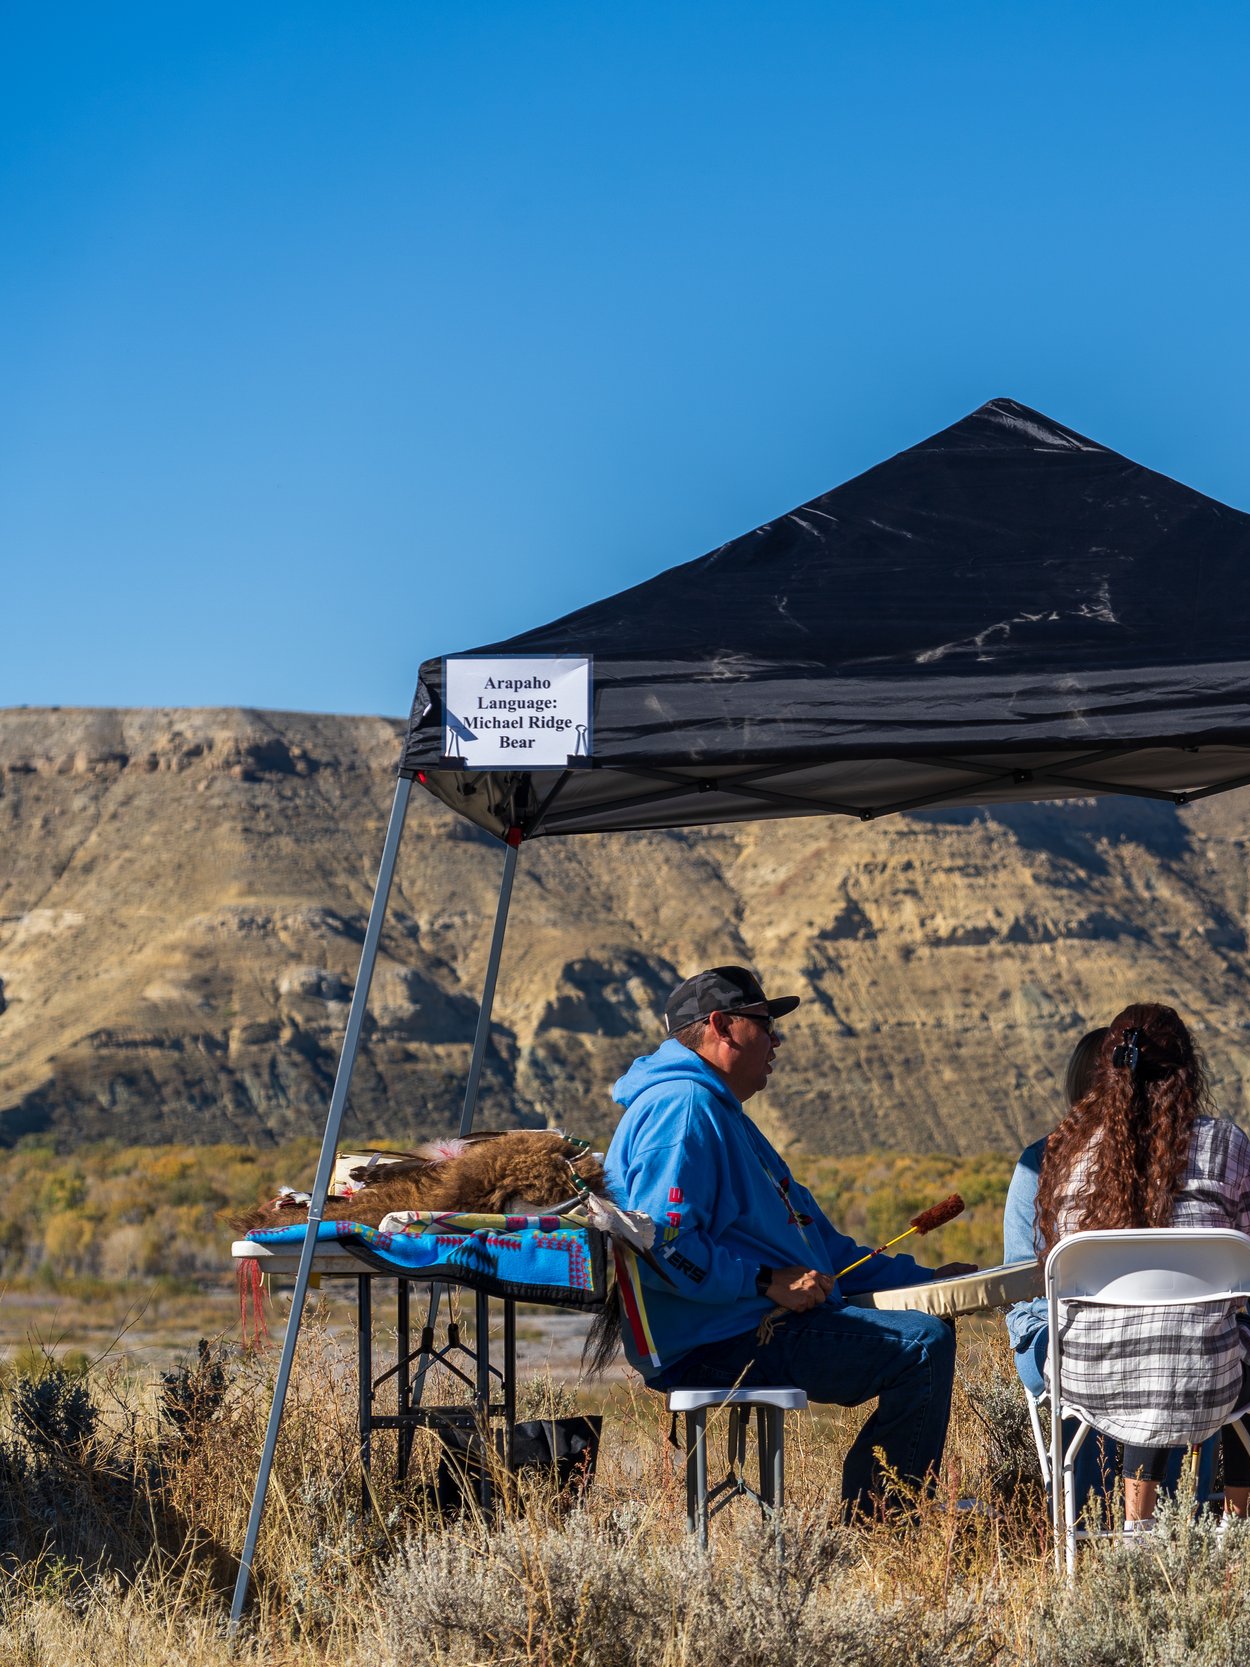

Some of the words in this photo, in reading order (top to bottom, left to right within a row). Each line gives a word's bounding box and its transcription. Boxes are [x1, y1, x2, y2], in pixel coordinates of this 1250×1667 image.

[484, 677, 551, 692] Arapaho
[477, 697, 558, 712] Language:
[463, 716, 523, 729] Michael
[528, 716, 573, 731] Ridge
[499, 735, 536, 749] Bear
